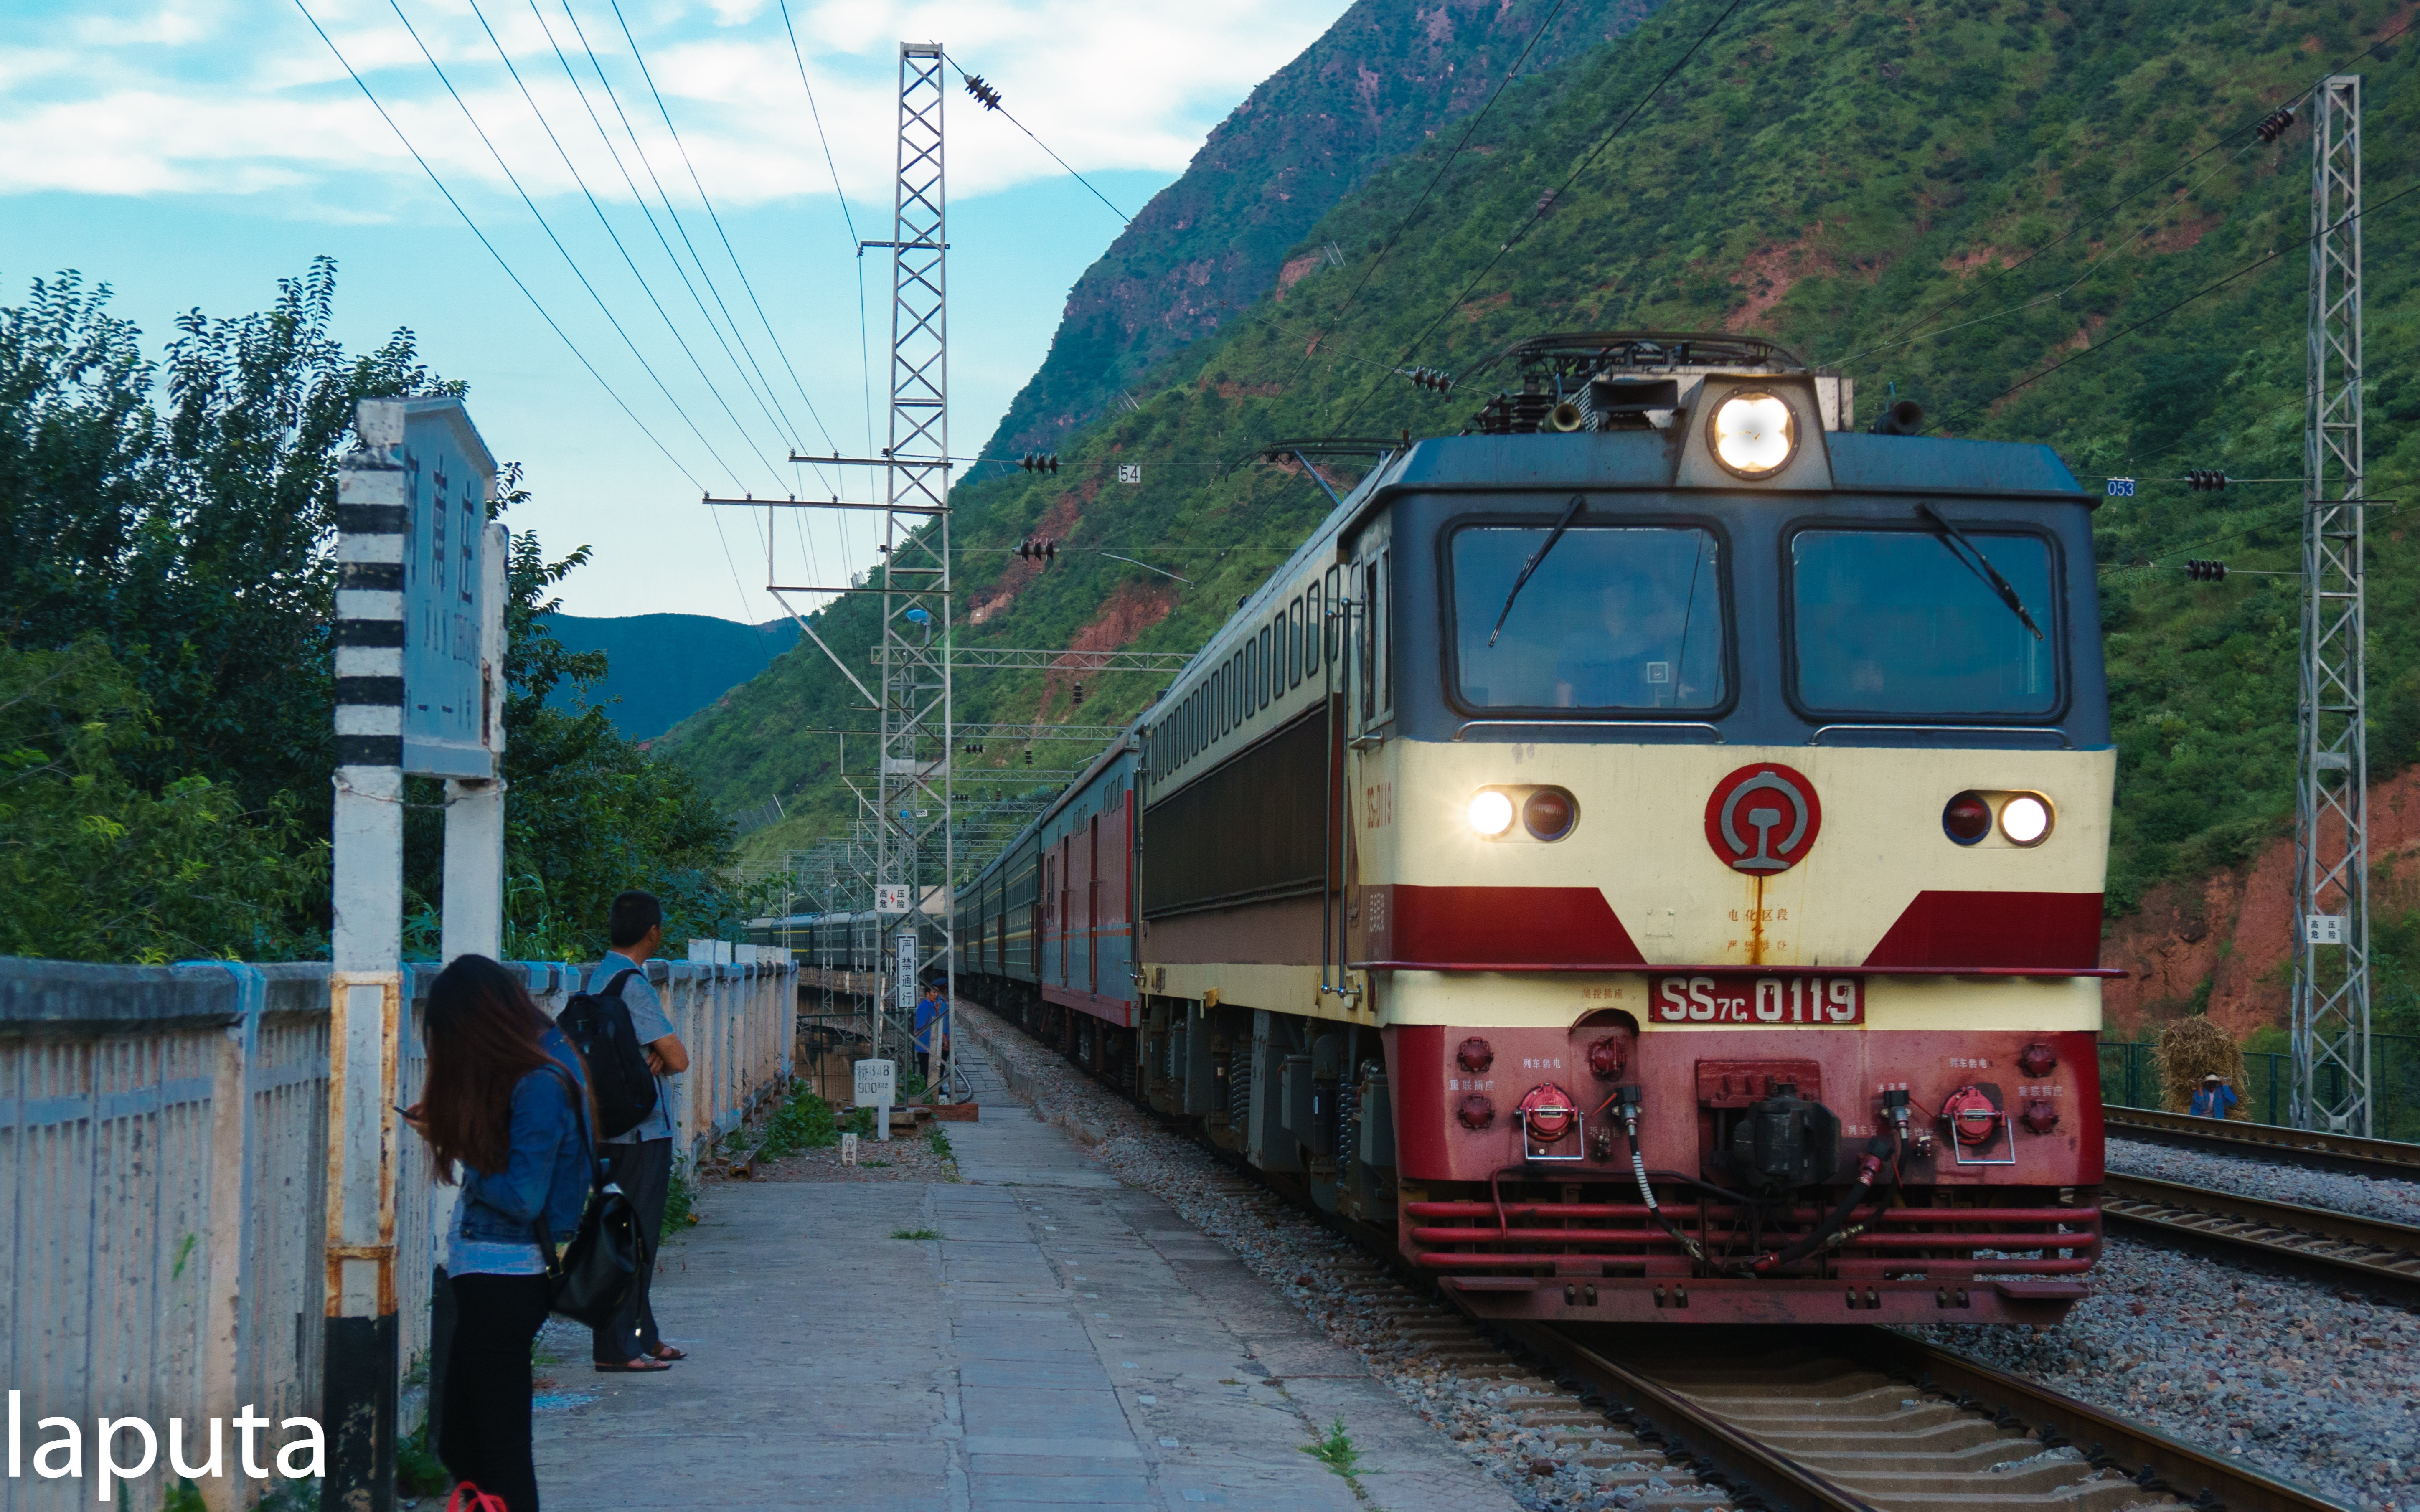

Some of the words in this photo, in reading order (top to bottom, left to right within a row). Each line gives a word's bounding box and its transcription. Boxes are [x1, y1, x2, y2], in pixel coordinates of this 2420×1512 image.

[1121, 465, 1138, 482] 54
[2108, 482, 2134, 496] 053
[879, 889, 904, 898] 高压
[879, 899, 904, 908] 危险
[1728, 909, 1788, 922] 电化区段
[2311, 920, 2336, 929] 高压
[902, 940, 912, 1005] 严禁通行
[1523, 1058, 1562, 1069] 列车供电
[1949, 1058, 1988, 1069] 列车供电
[1450, 1079, 1495, 1092] 重联插座
[2018, 1086, 2063, 1097] 重联插座
